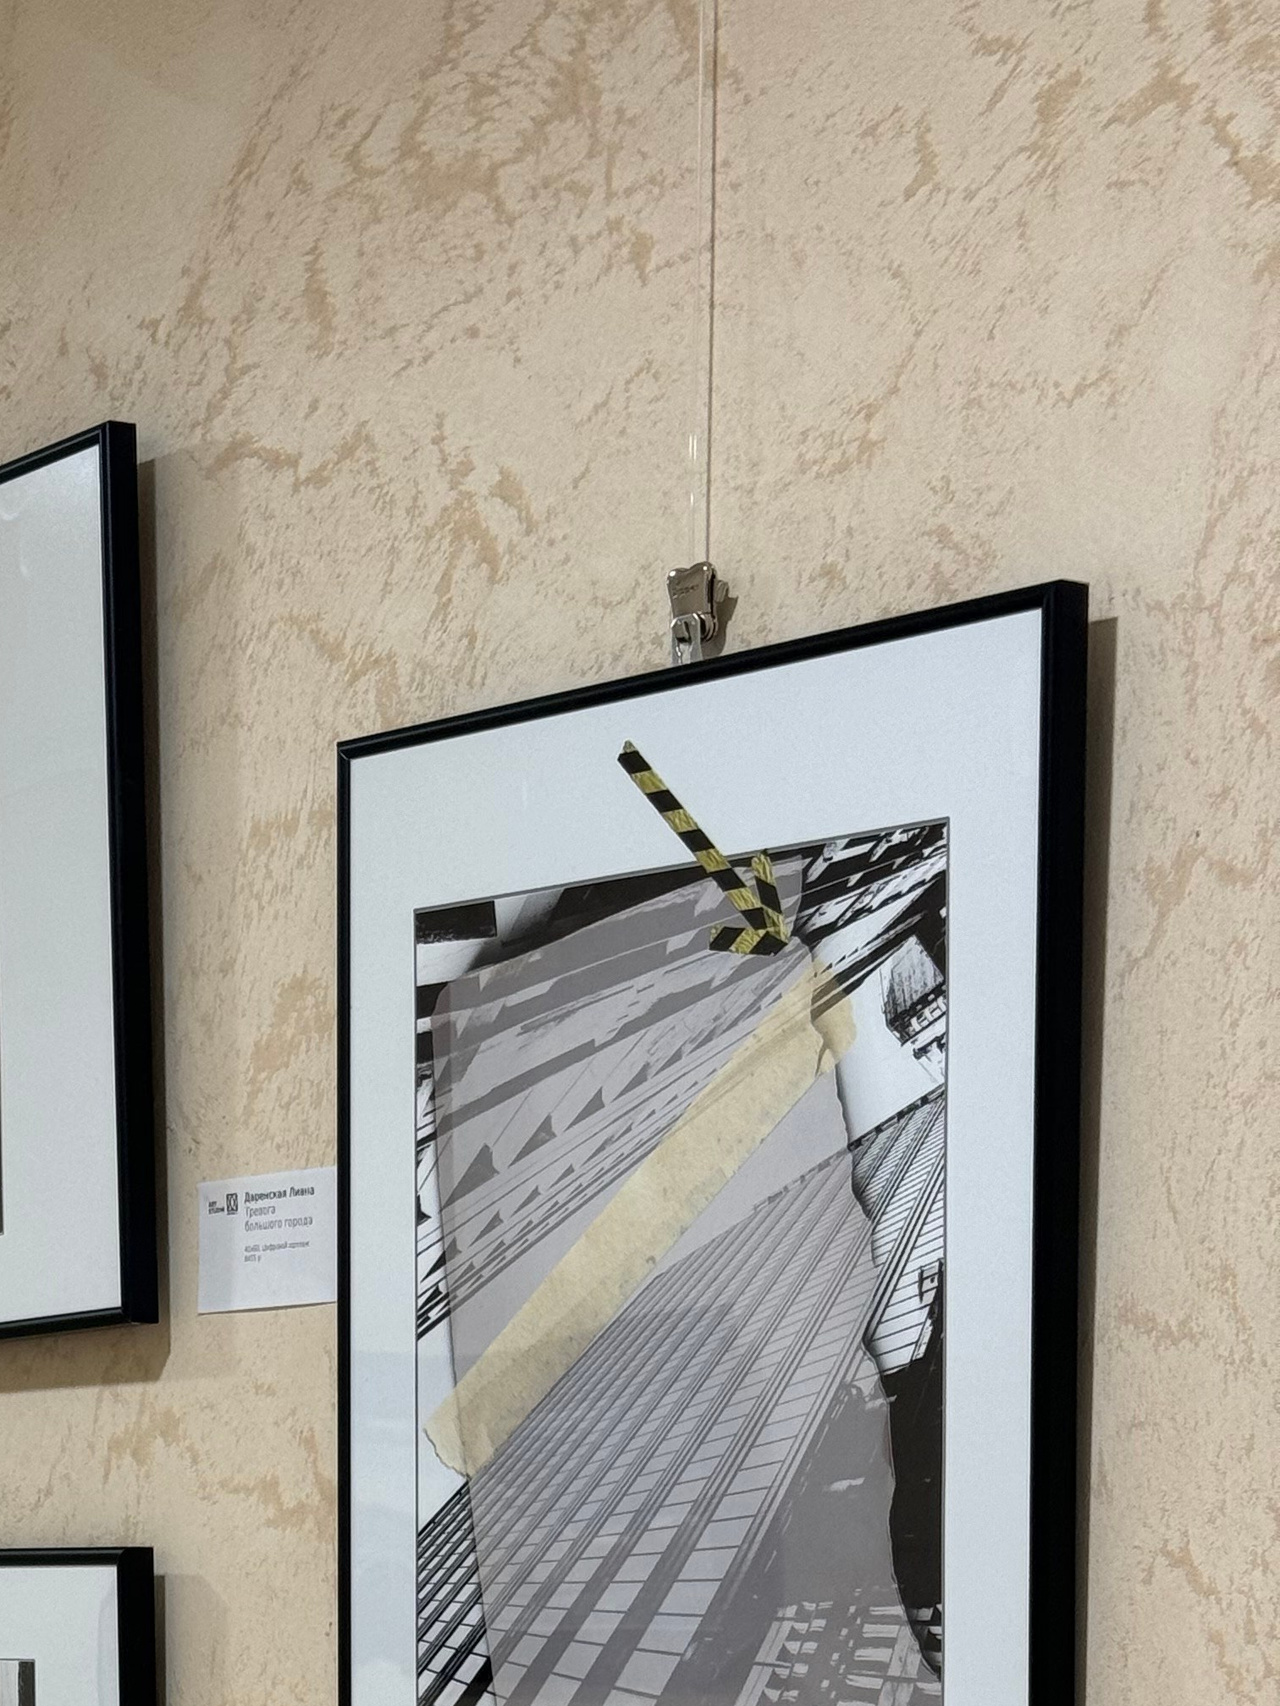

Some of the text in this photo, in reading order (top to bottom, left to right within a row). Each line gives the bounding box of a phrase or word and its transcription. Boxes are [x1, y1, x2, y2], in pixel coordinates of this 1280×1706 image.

[289, 1186, 315, 1198] Лиана
[244, 1216, 313, 1232] большого города
